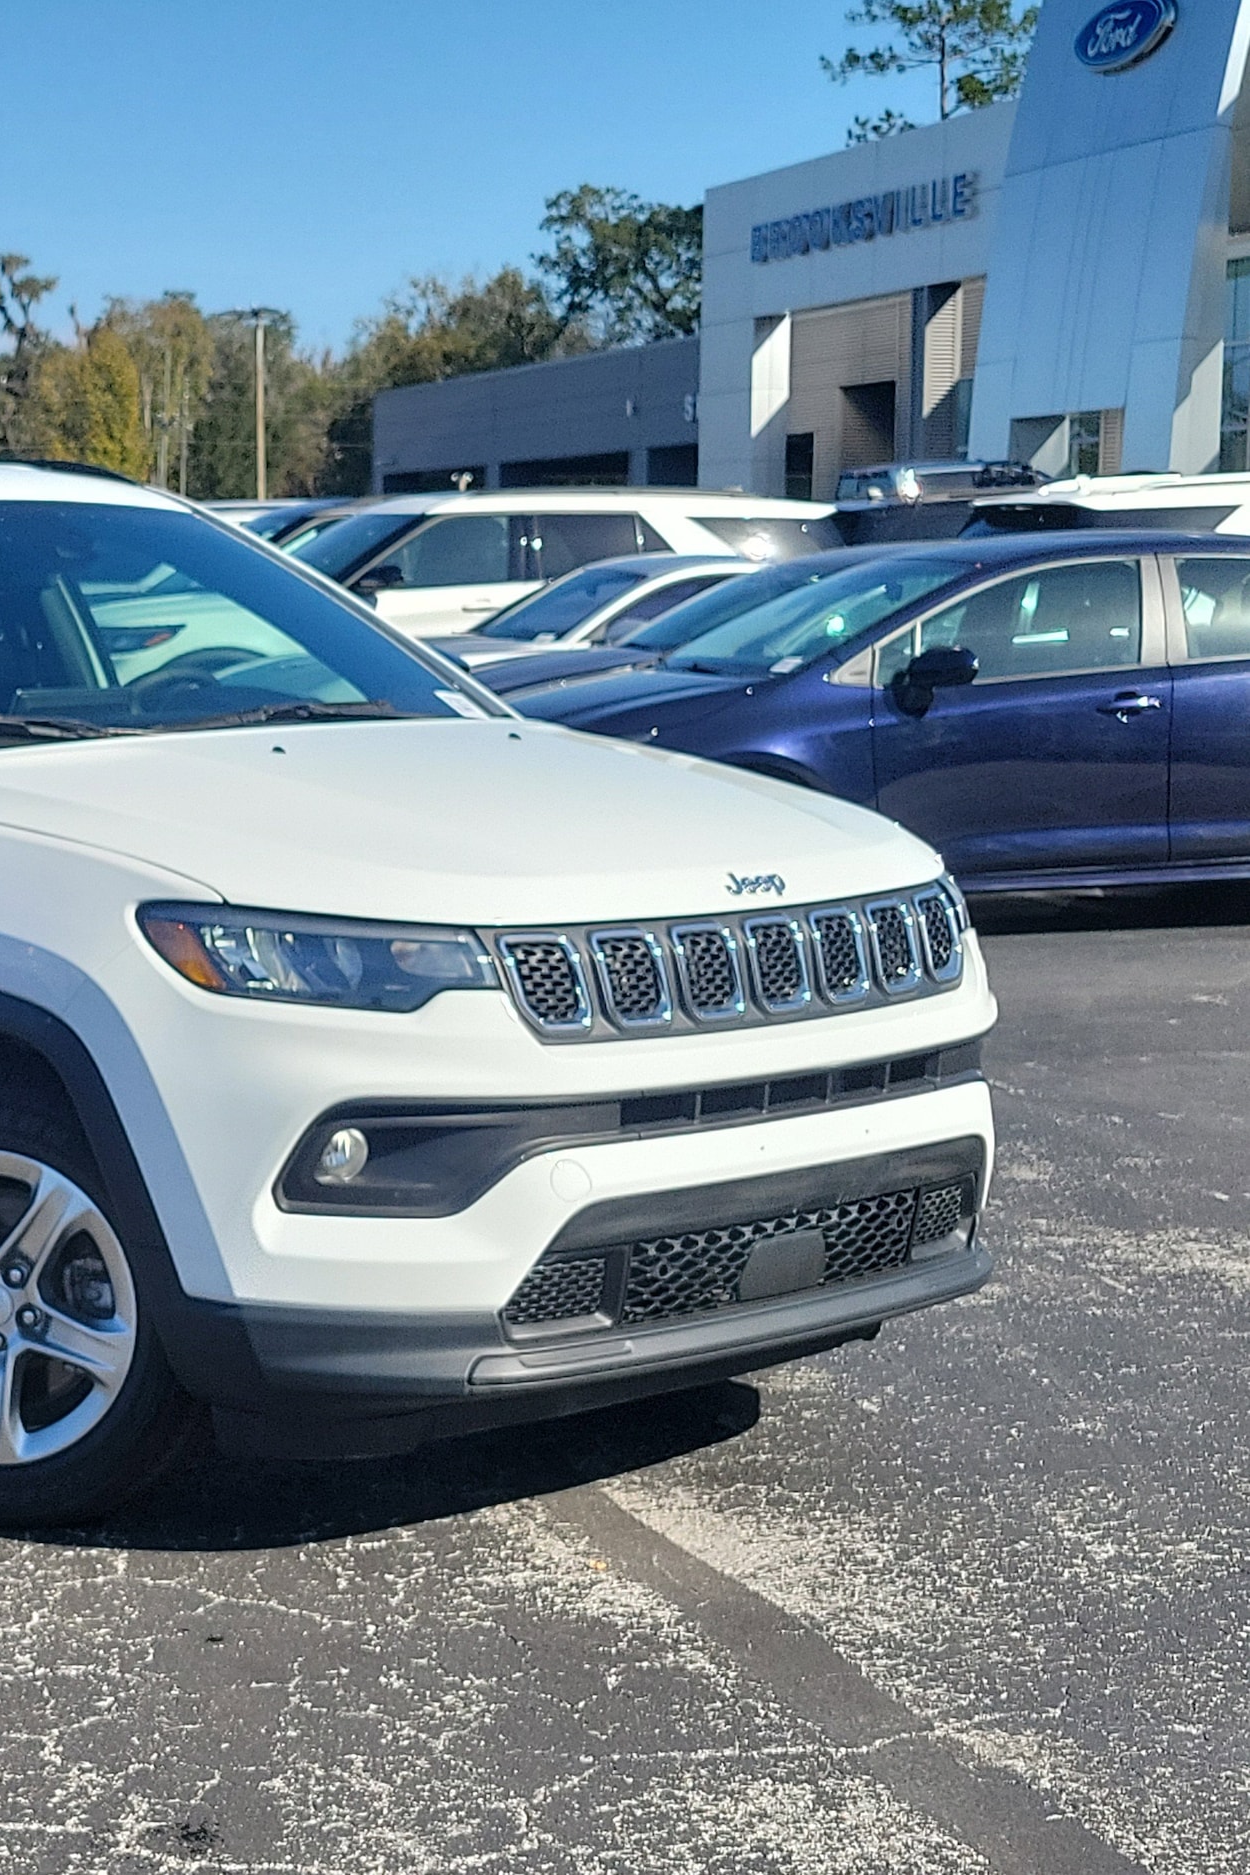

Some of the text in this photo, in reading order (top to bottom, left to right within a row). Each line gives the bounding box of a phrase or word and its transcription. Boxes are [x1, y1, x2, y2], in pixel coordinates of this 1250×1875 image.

[1087, 8, 1142, 57] Ford
[751, 172, 969, 263] BROOKSVILLE
[725, 872, 786, 896] Jeep
